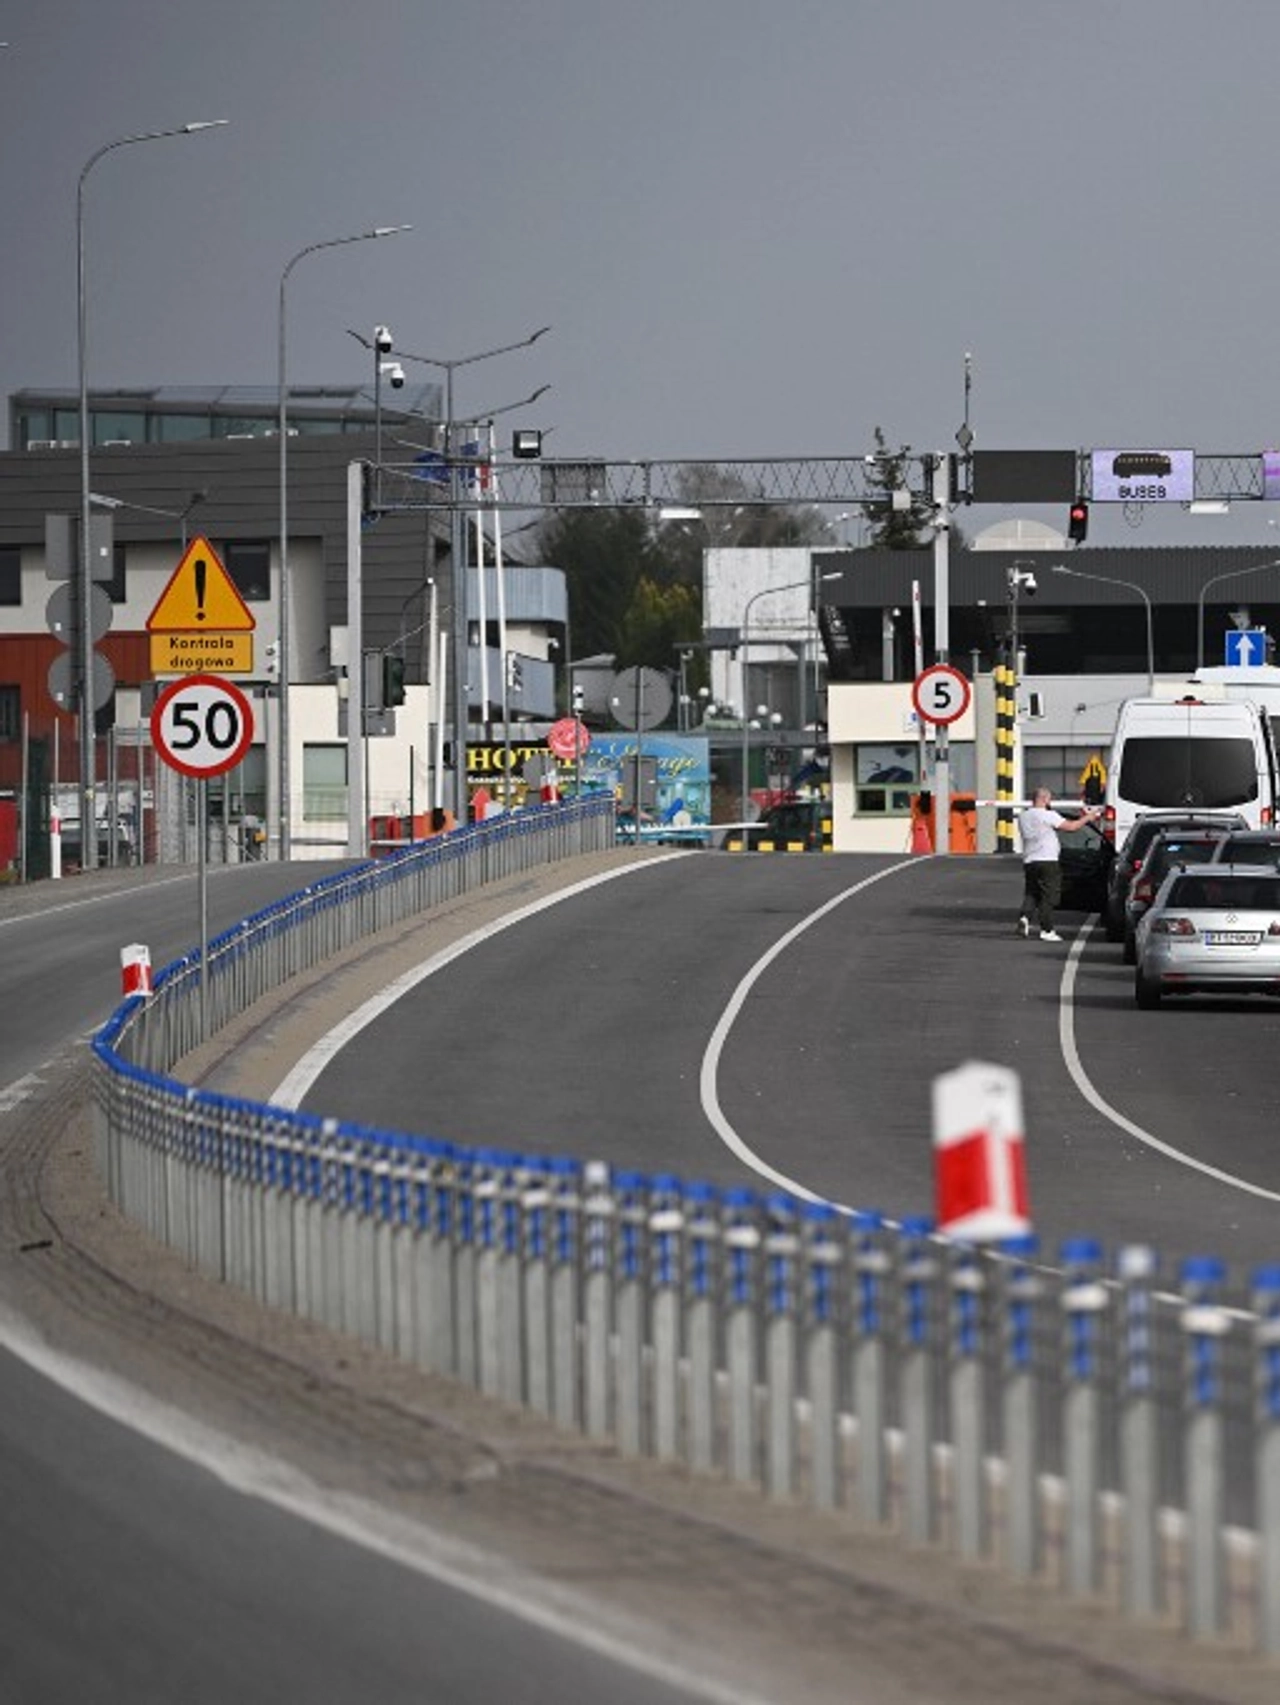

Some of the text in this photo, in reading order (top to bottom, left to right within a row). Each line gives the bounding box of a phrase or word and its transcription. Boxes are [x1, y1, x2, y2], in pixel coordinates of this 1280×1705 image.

[1118, 485, 1167, 499] BUSES
[169, 637, 234, 649] Kontrola
[169, 655, 234, 671] drogowa
[934, 682, 951, 709] 5
[171, 700, 239, 750] 50
